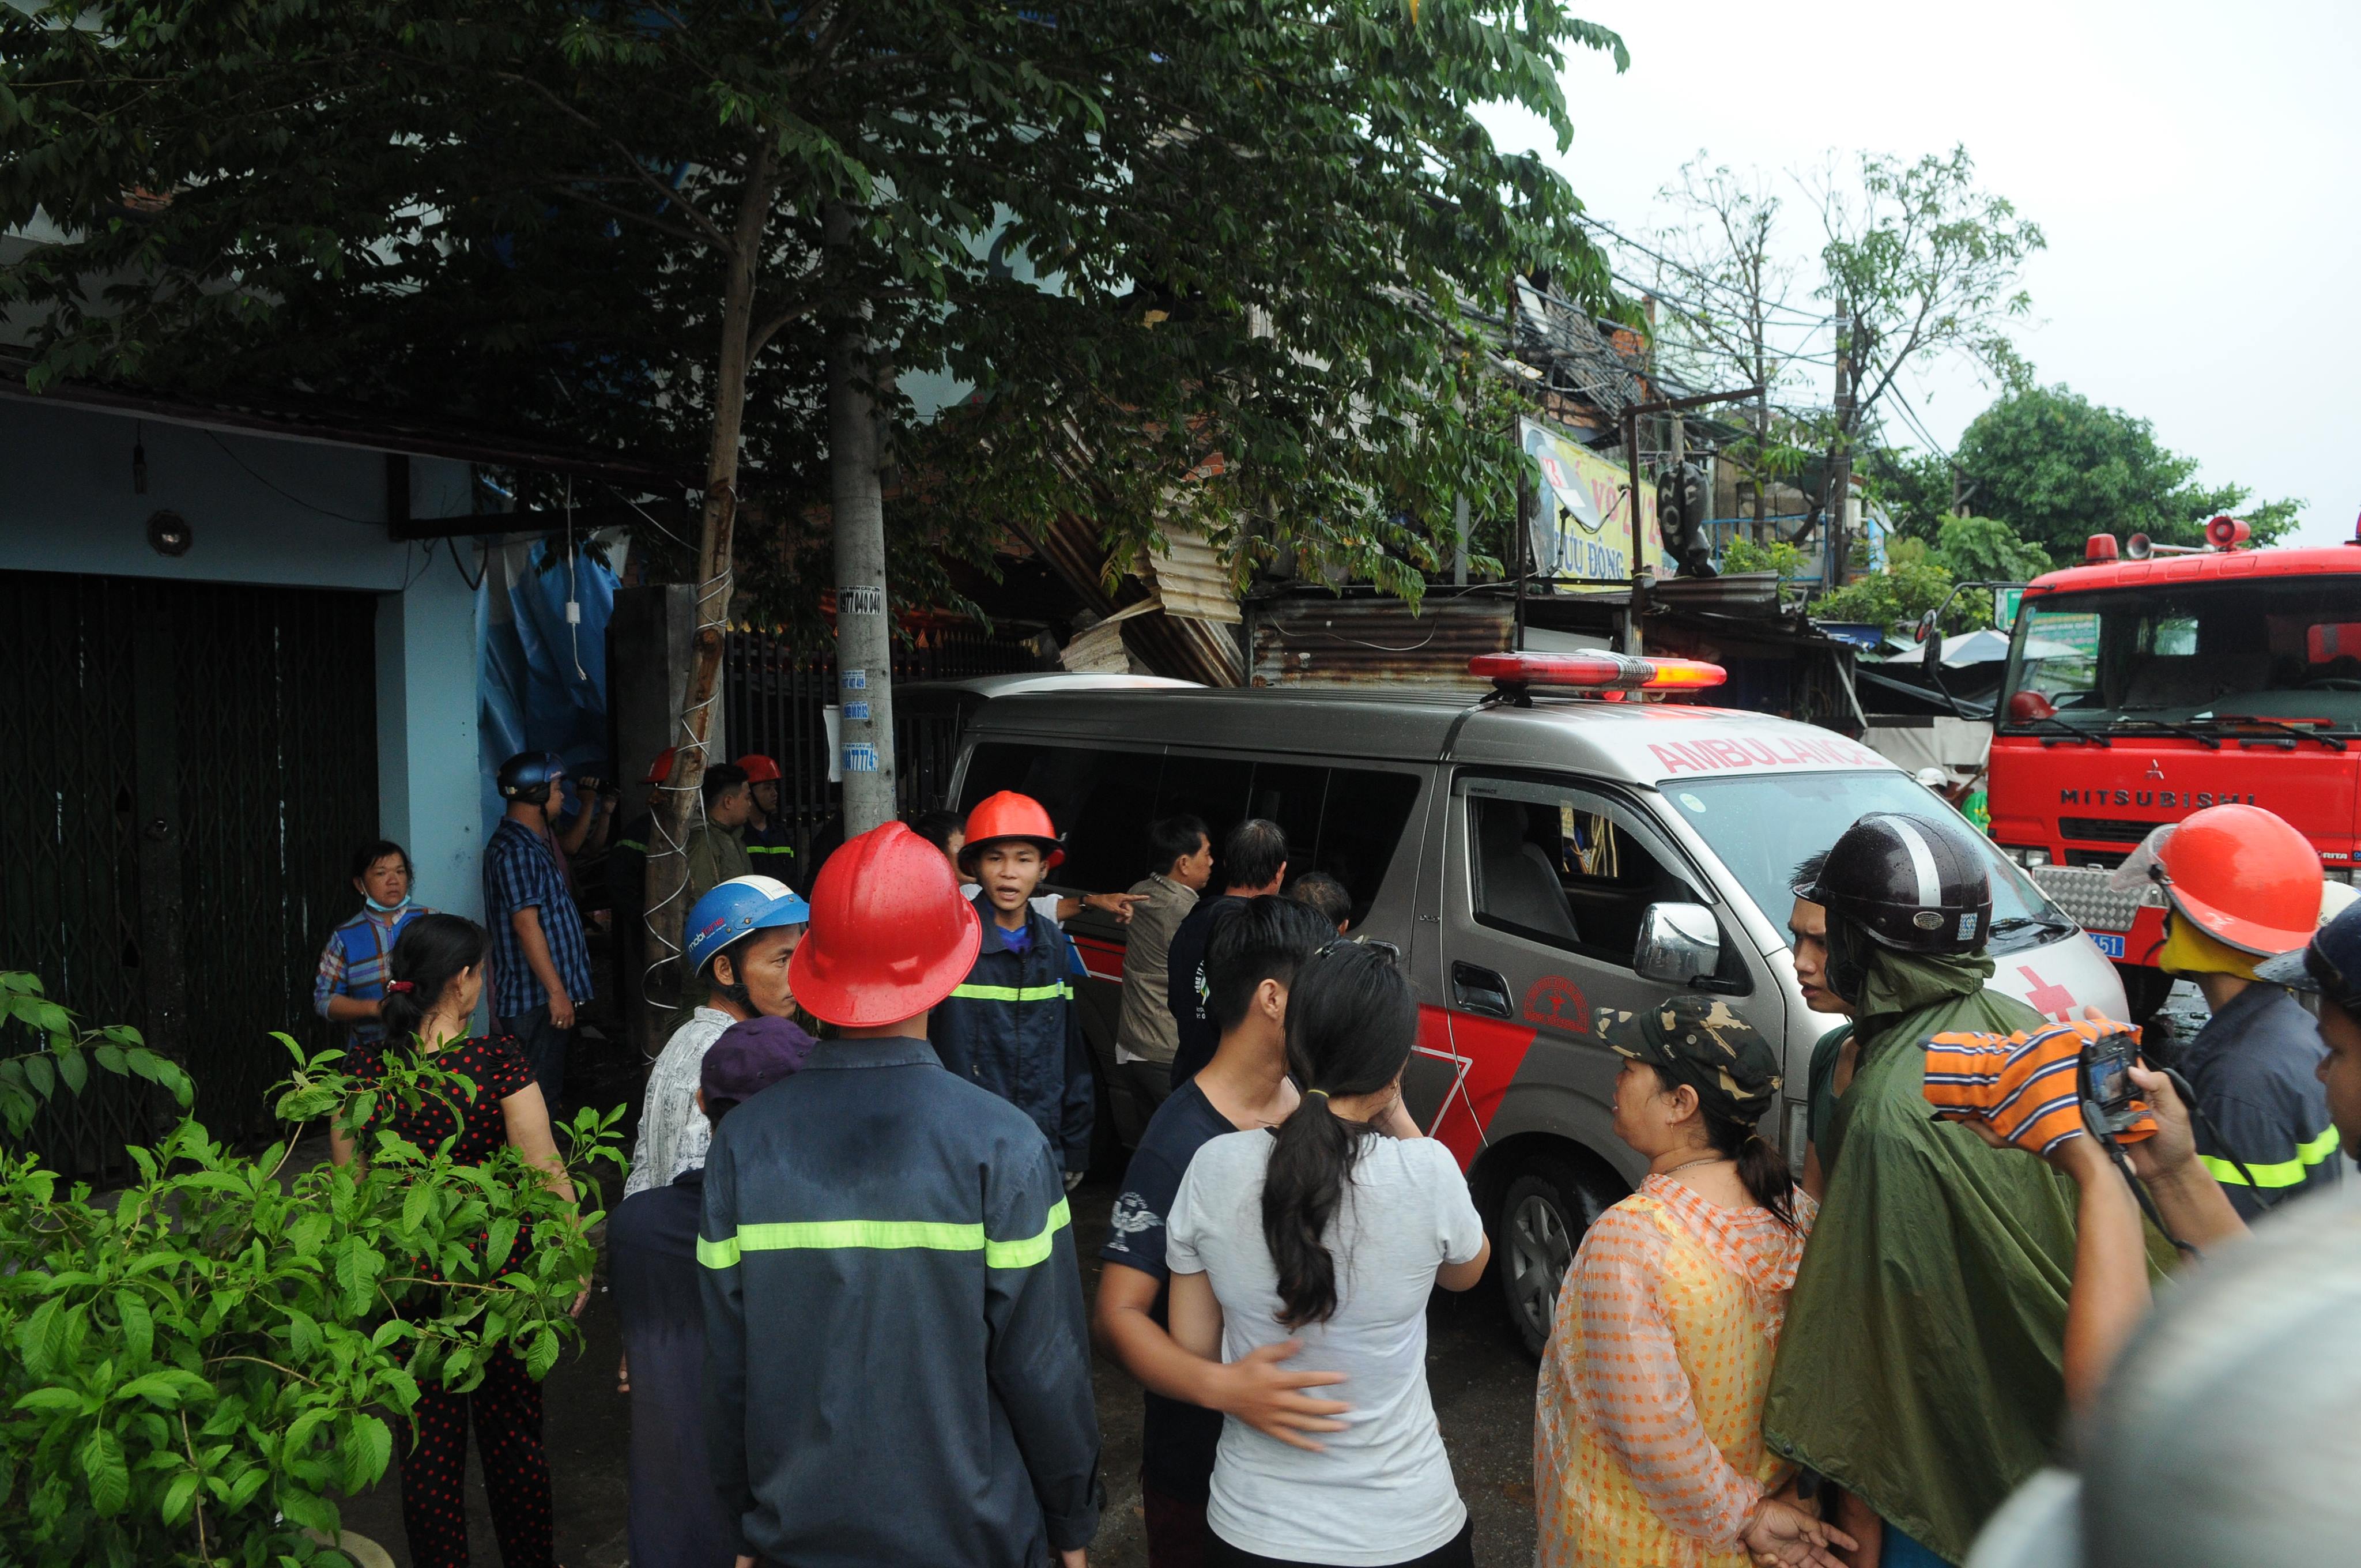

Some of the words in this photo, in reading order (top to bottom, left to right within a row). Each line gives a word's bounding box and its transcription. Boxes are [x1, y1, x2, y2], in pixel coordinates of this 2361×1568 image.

[1647, 737, 1884, 774] AMBULANCE
[2060, 789, 2255, 808] MITSUBISHI
[2092, 936, 2117, 955] 51
